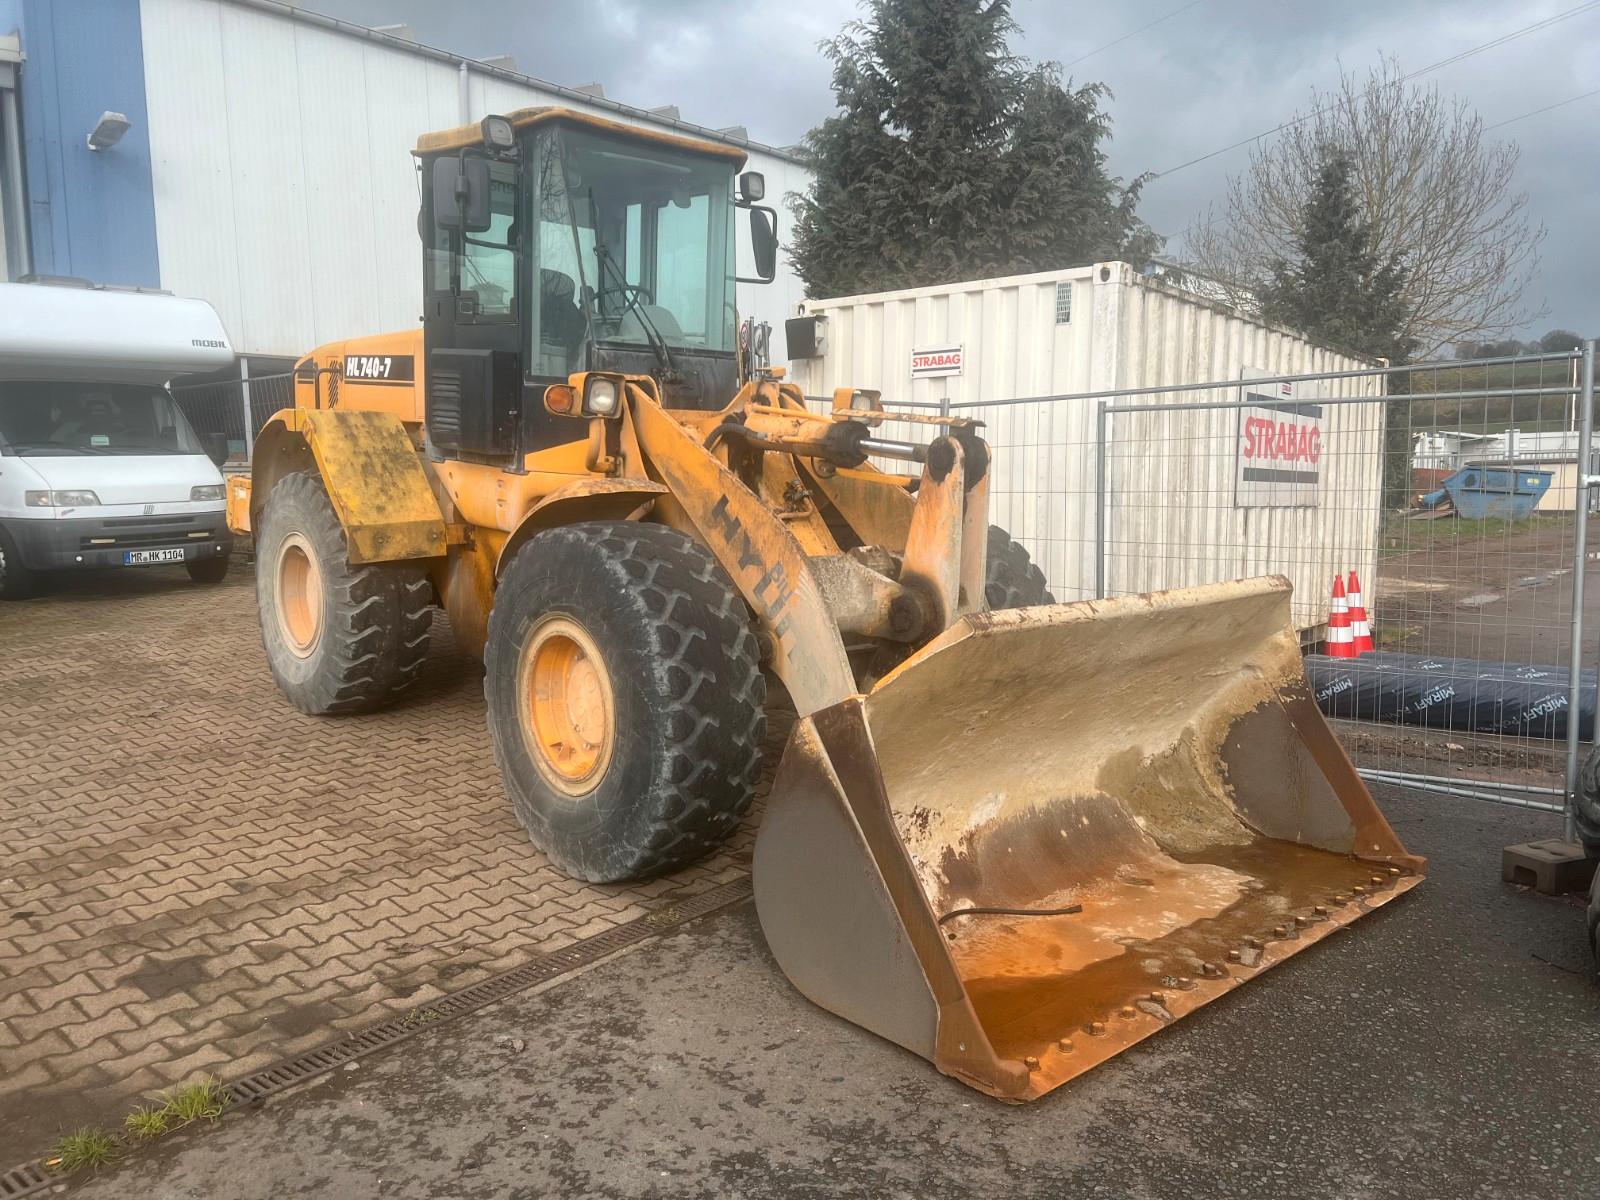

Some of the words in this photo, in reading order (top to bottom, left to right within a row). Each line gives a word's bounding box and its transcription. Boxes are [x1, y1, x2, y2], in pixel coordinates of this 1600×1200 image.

[191, 339, 227, 349] MOBIL
[346, 357, 392, 378] HL740-7
[912, 354, 961, 368] STRABAG
[1243, 415, 1320, 464] STRABAG
[131, 552, 143, 563] MR
[149, 551, 160, 561] HK
[162, 550, 183, 560] 1104
[1414, 685, 1456, 711] MIRAFI
[1522, 694, 1568, 720] MIRAFI
